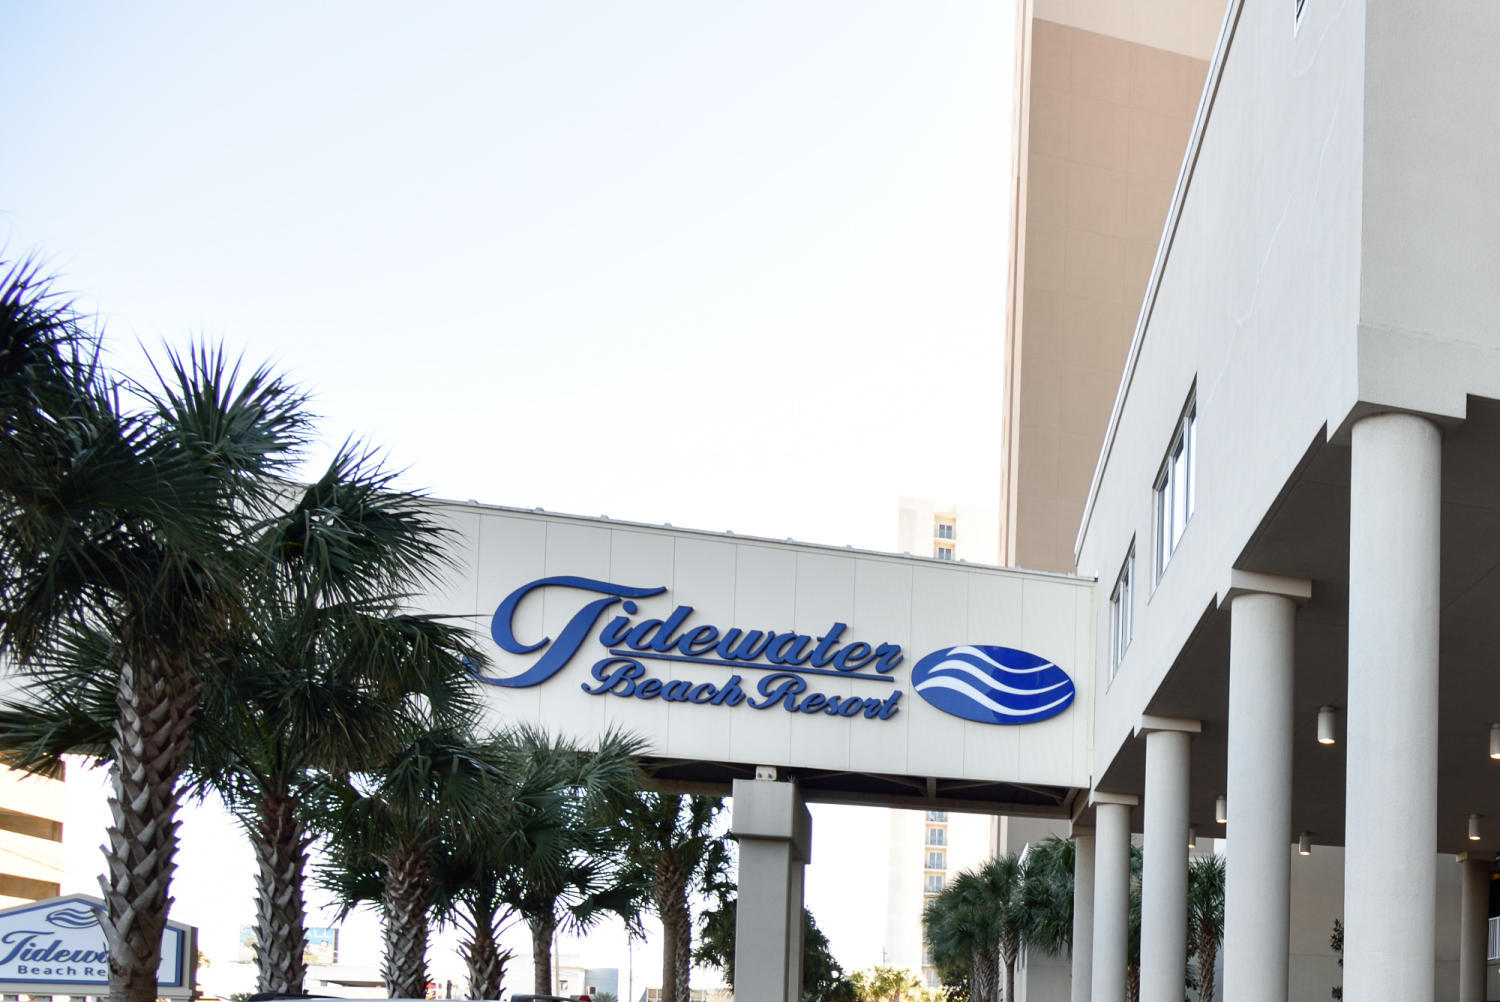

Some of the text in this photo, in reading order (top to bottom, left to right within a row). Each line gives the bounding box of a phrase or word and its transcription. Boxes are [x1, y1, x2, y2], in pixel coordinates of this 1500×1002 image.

[463, 575, 904, 688] Tidewater
[581, 657, 903, 720] Beach Resort
[0, 930, 109, 966] Tidewa
[18, 965, 77, 976] Beach
